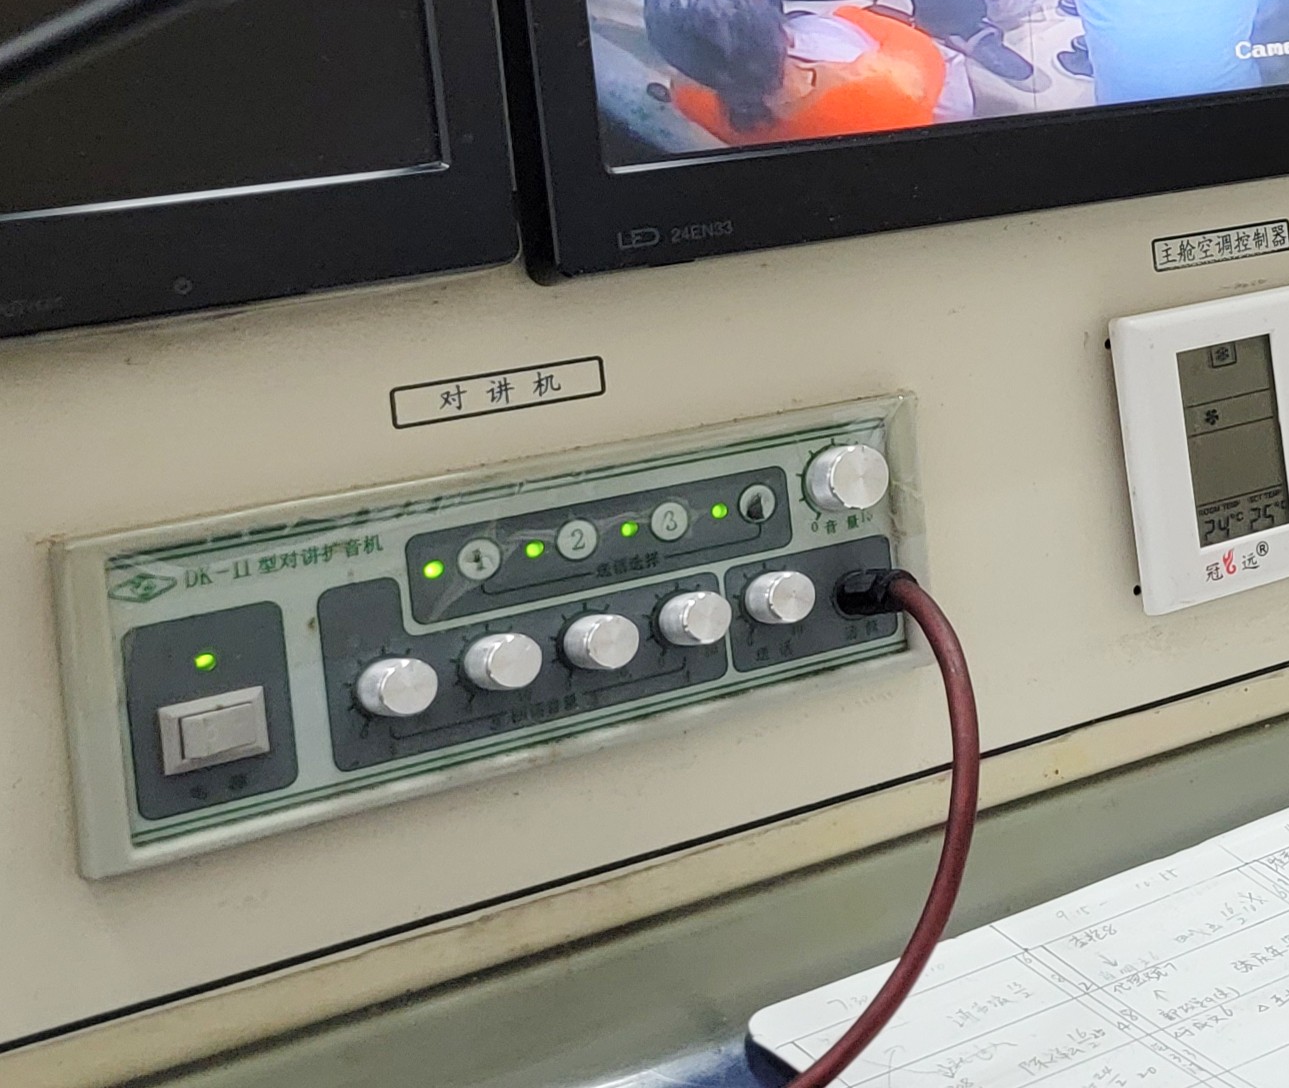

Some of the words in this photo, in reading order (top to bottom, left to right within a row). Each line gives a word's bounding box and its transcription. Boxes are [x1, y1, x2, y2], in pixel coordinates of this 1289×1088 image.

[1159, 223, 1287, 266] 主舱空调控制器
[439, 371, 562, 413] 对讲机
[571, 528, 585, 551] 2
